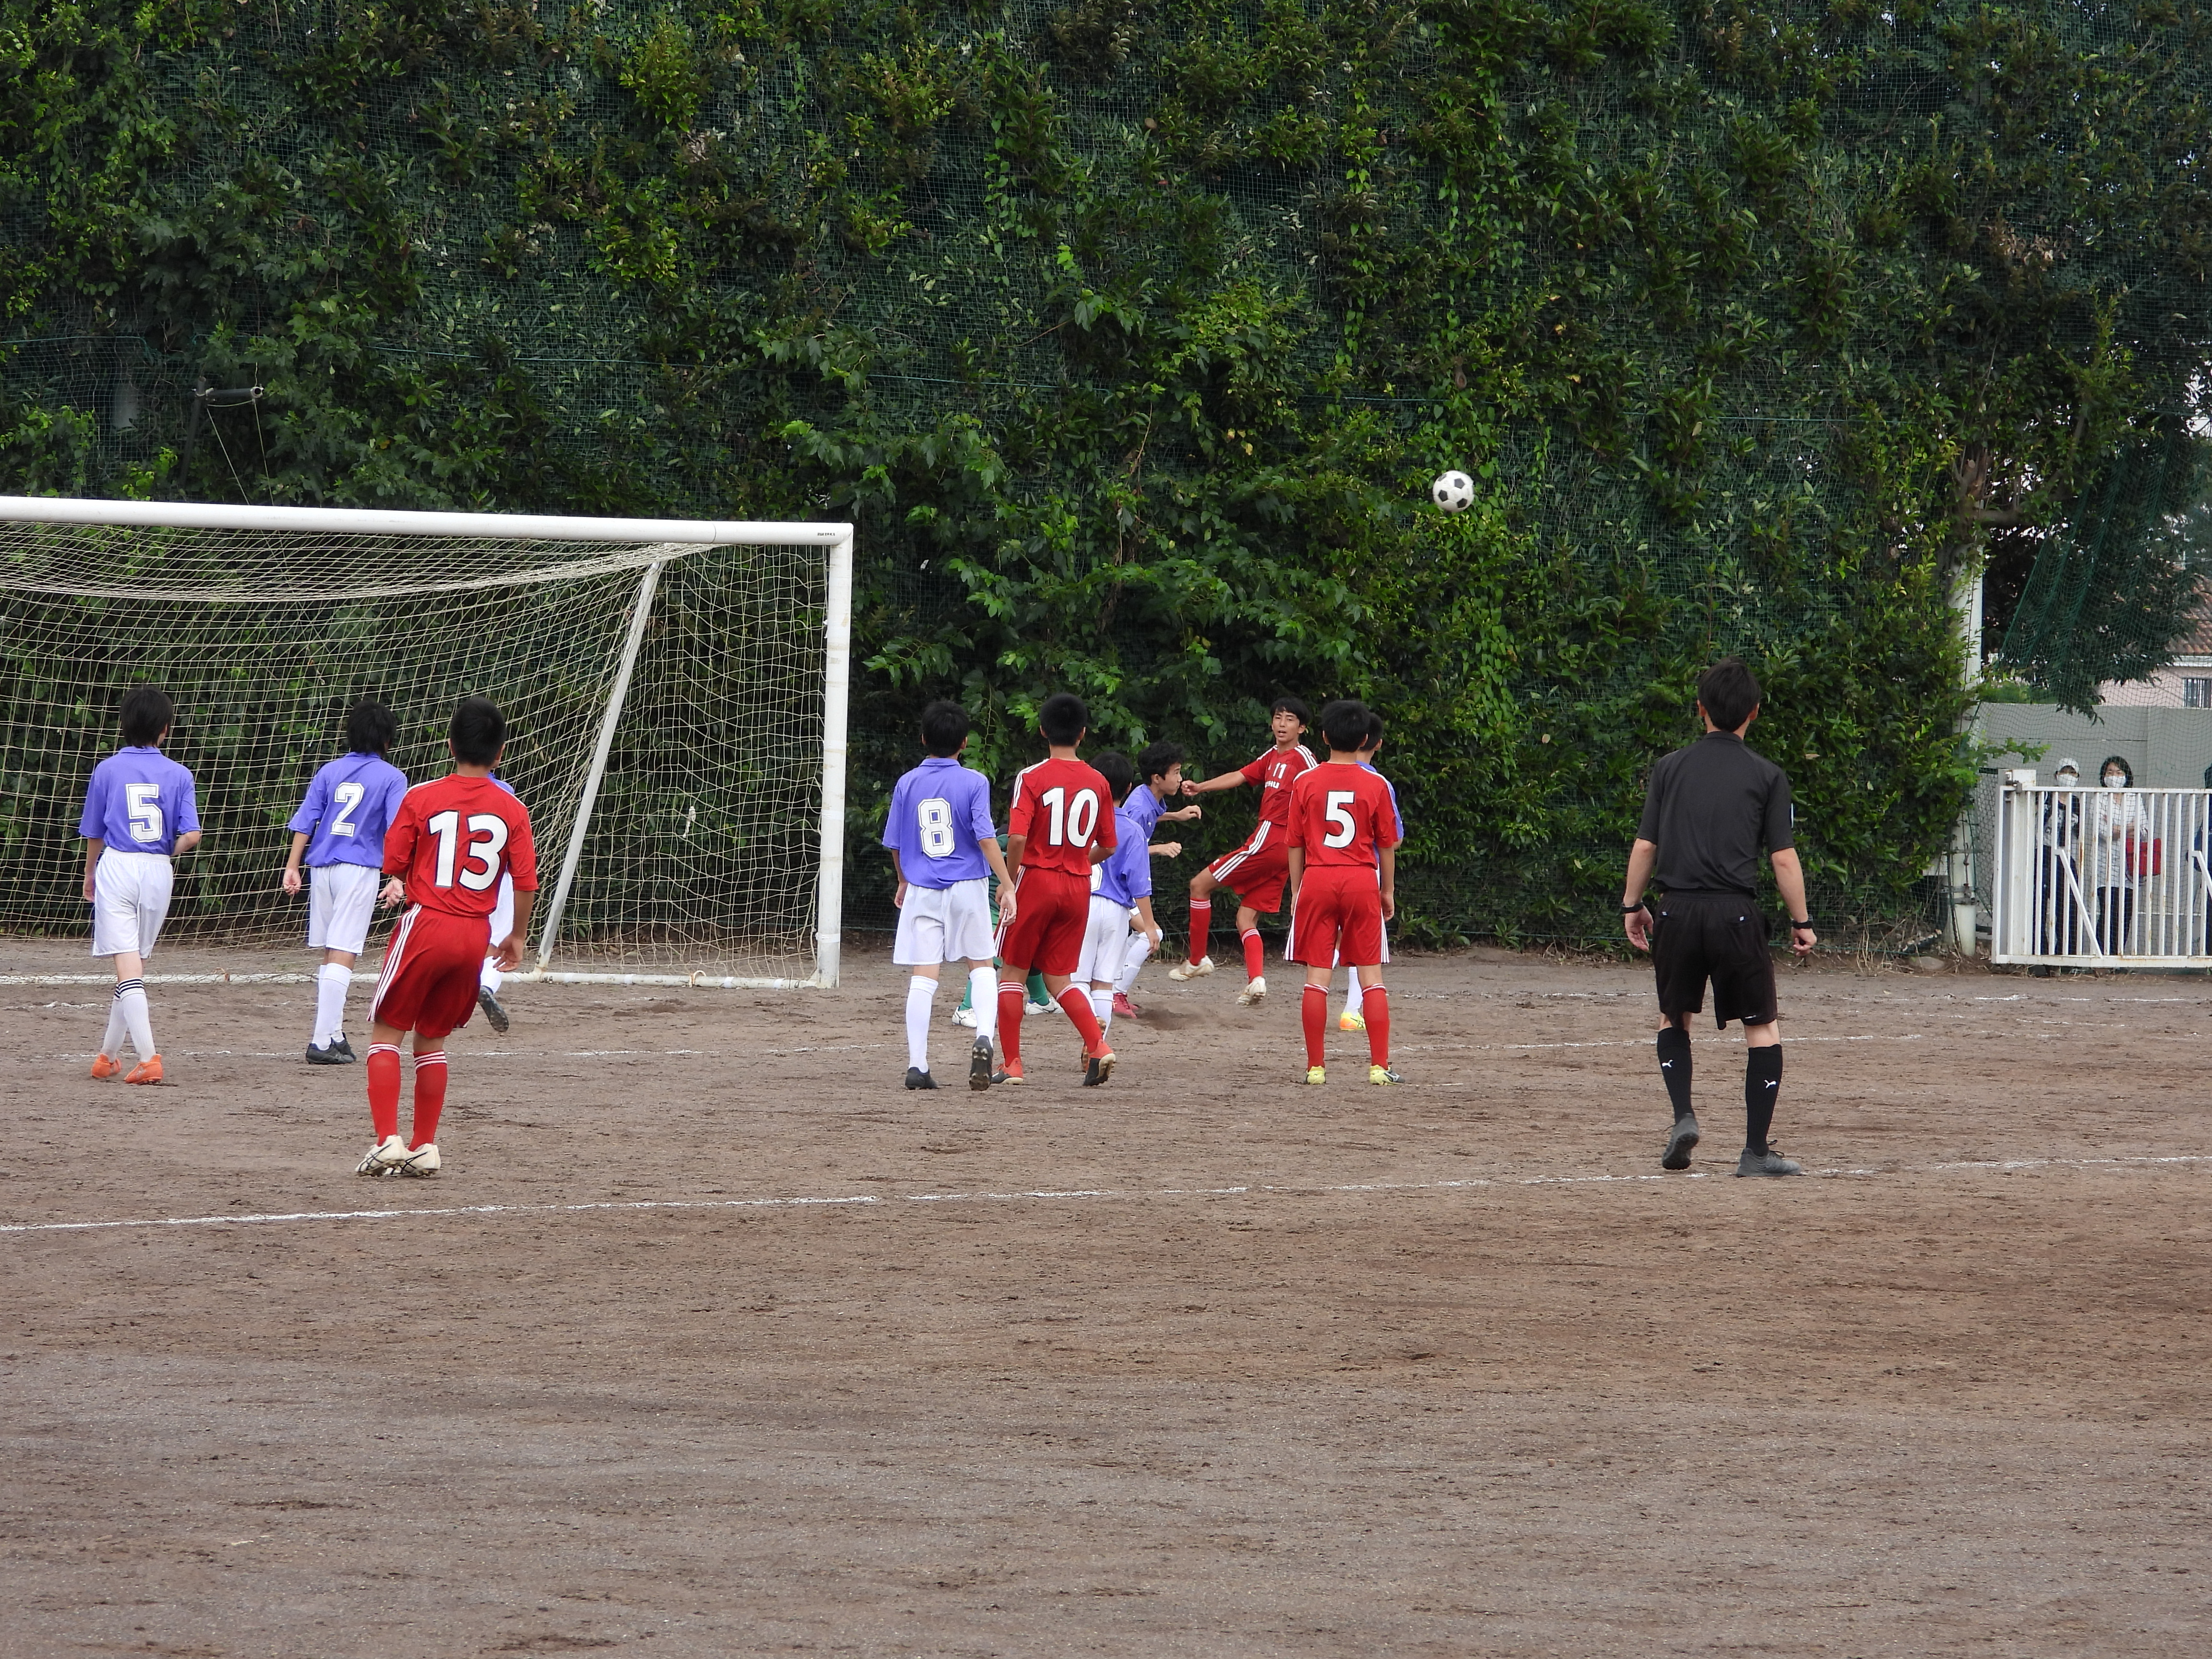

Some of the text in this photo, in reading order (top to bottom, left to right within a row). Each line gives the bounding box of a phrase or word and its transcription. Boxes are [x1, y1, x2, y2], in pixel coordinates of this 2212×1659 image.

[1273, 762, 1287, 779] 11
[126, 783, 162, 842] 5
[330, 782, 364, 837] 2
[917, 797, 955, 858] 8
[1042, 787, 1099, 848] 10
[1323, 791, 1356, 849] 5
[427, 809, 508, 891] 13
